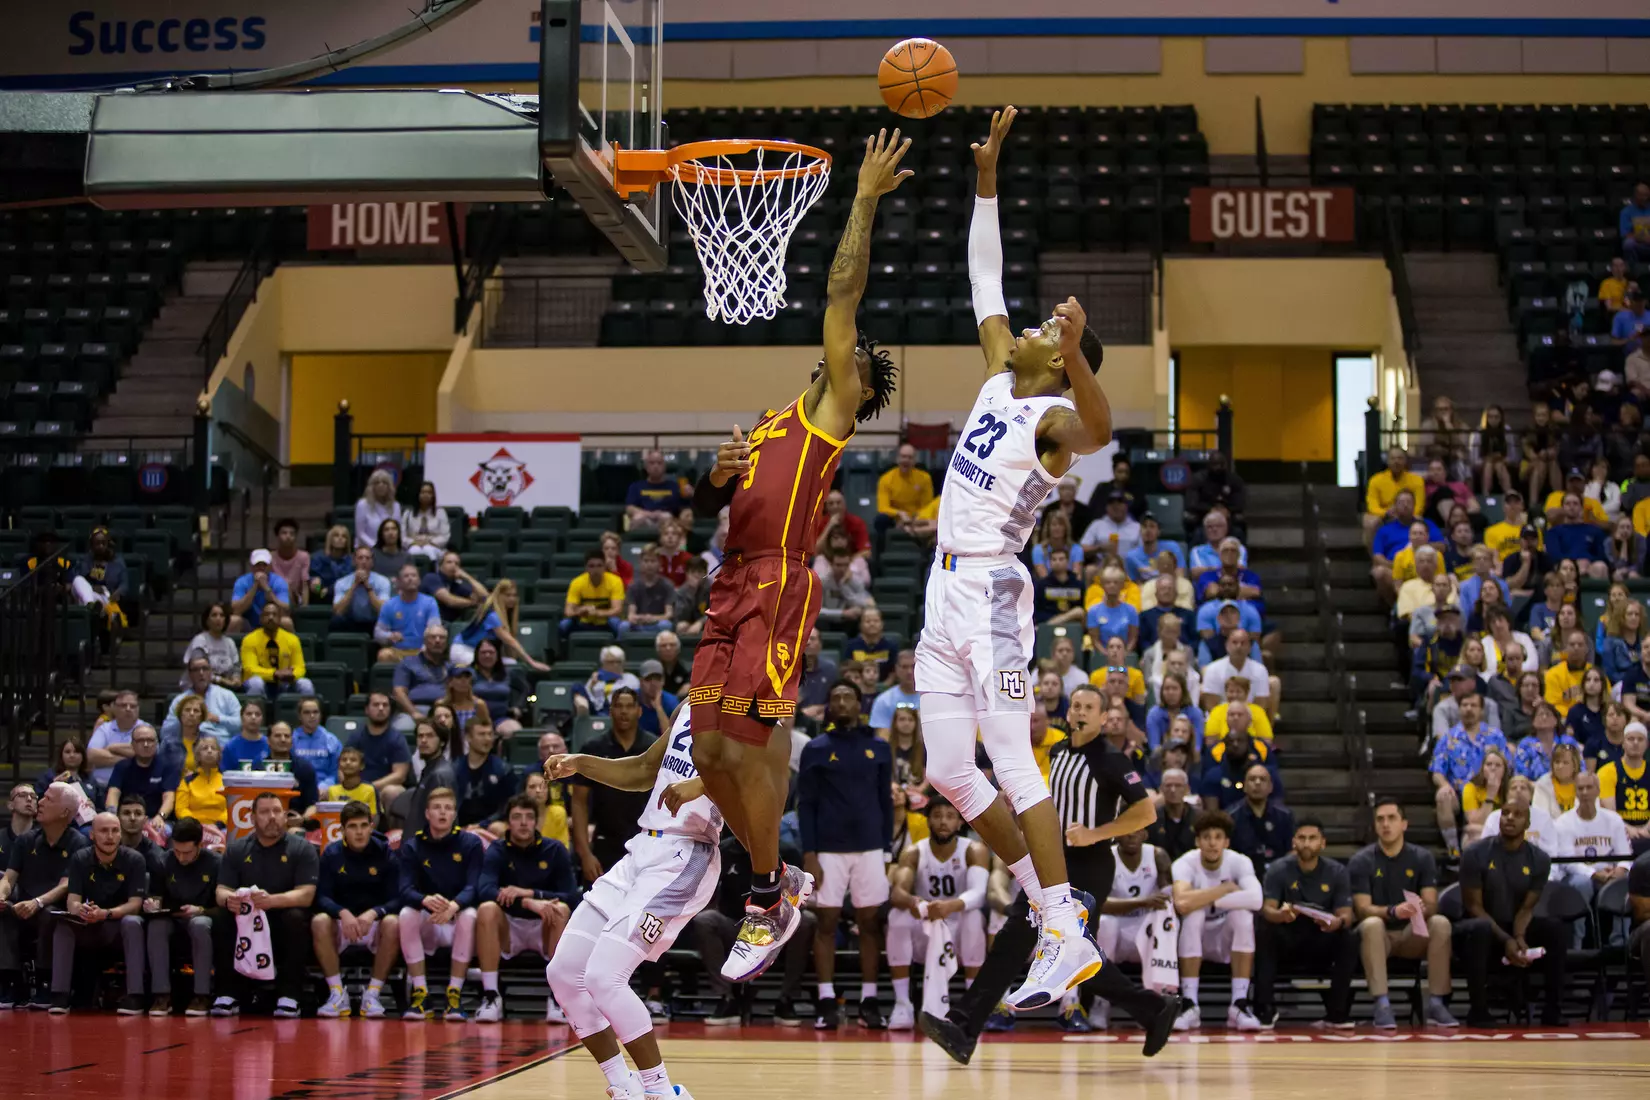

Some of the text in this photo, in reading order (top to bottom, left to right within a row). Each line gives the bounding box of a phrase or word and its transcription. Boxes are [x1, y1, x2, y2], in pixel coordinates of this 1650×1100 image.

[68, 11, 266, 56] Success
[331, 201, 440, 245] HOME
[1211, 191, 1333, 238] GUEST
[747, 410, 793, 451] SC
[963, 412, 1007, 460] 23
[998, 670, 1026, 700] MU
[231, 799, 257, 830] G
[1624, 787, 1649, 811] 33
[326, 823, 344, 843] G
[928, 874, 956, 898] 30
[639, 912, 664, 945] MU
